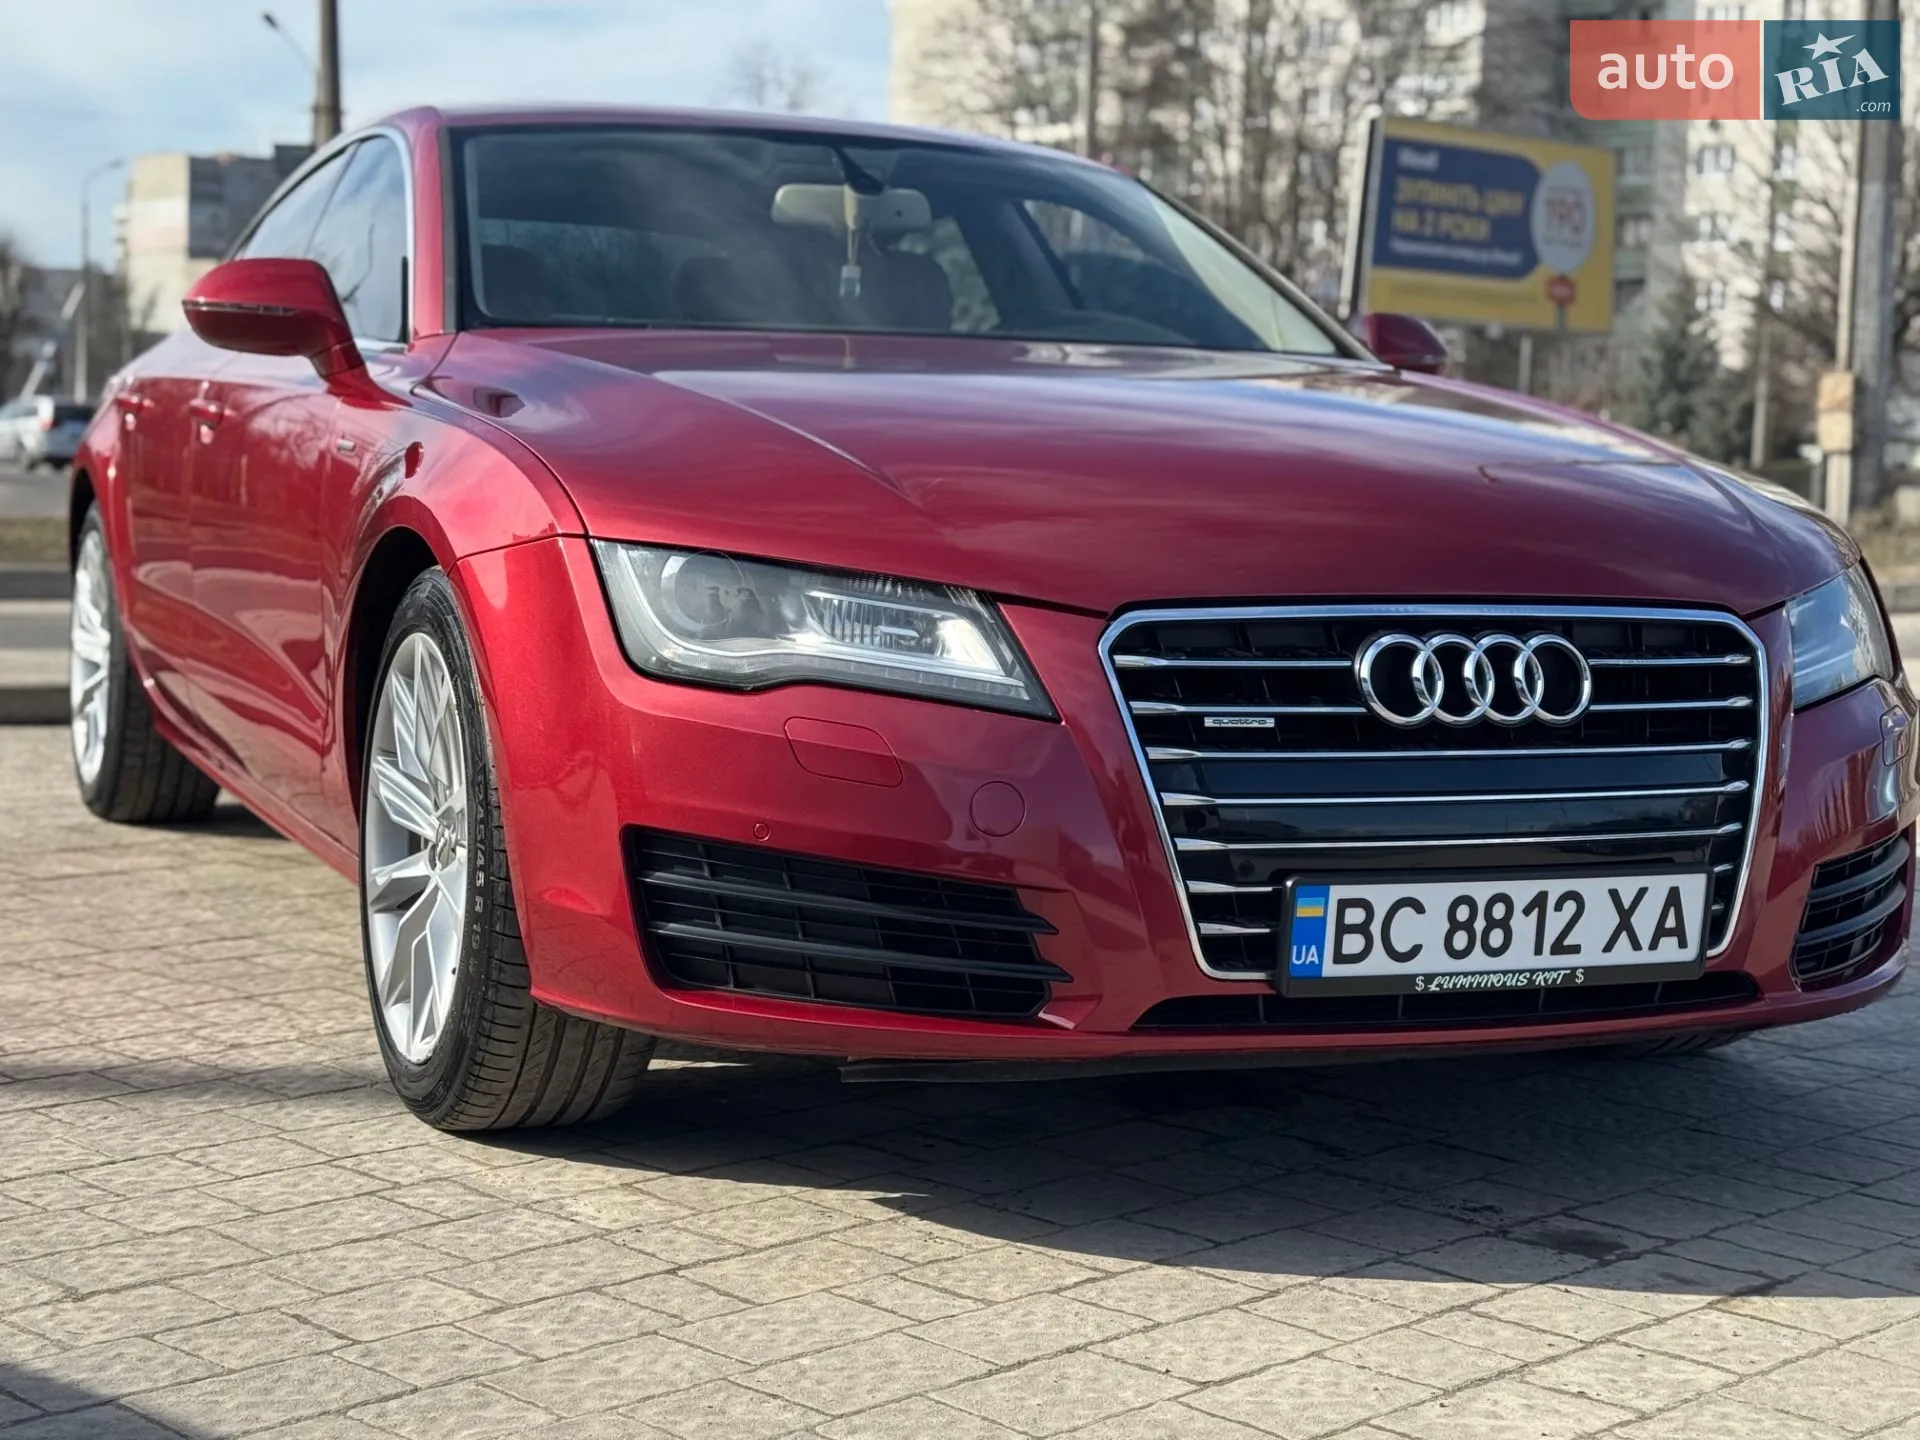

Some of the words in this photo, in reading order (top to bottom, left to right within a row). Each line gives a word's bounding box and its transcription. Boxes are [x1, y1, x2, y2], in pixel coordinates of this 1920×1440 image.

[1211, 718, 1267, 726] quattro
[474, 895, 484, 913] R
[1332, 896, 1426, 965] BC
[1443, 889, 1586, 960] 8812
[1601, 886, 1689, 953] XA
[1292, 945, 1320, 965] UA
[1427, 972, 1530, 992] LUMINOUS
[1532, 969, 1571, 986] KIT
